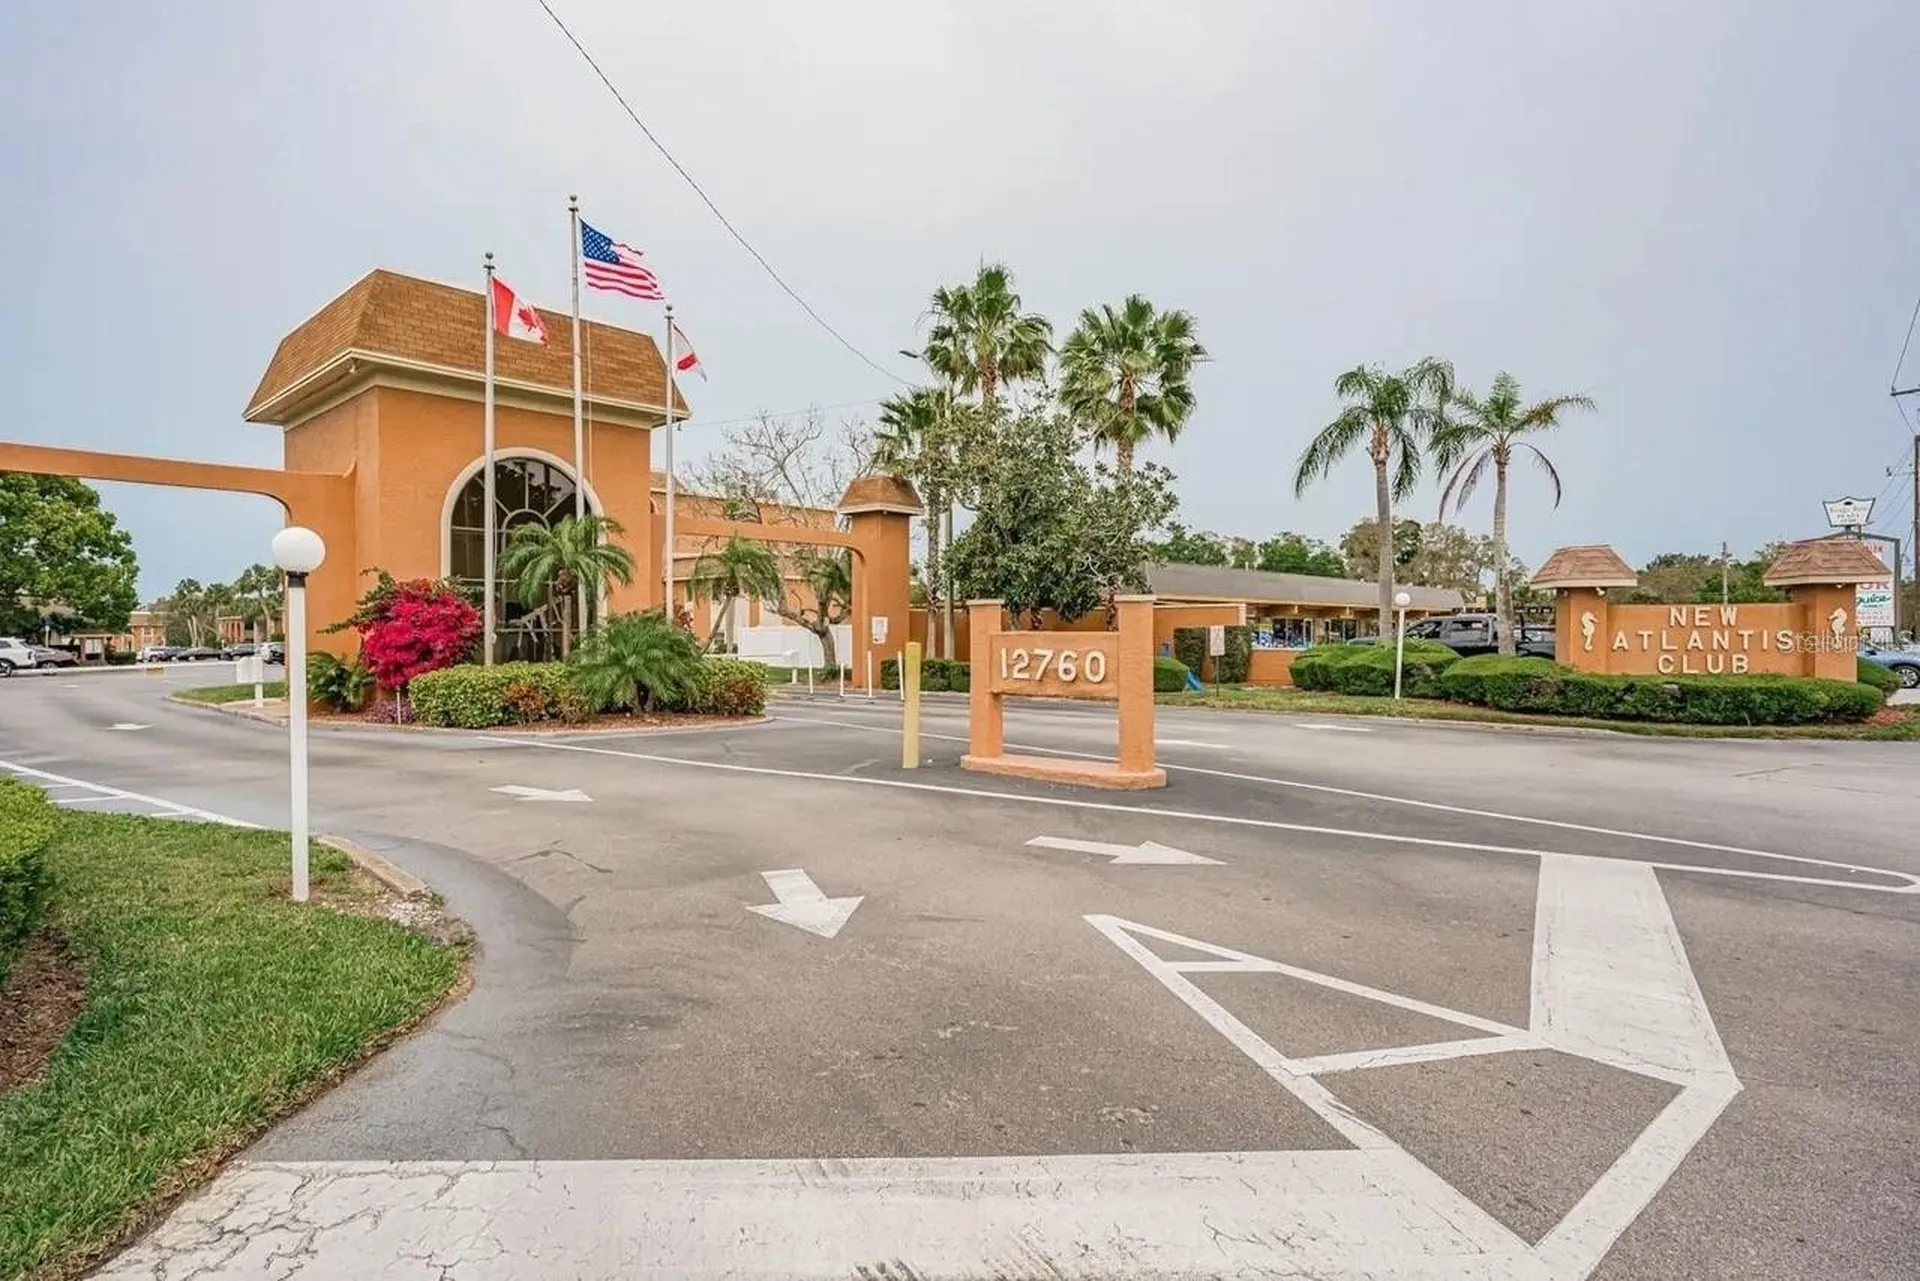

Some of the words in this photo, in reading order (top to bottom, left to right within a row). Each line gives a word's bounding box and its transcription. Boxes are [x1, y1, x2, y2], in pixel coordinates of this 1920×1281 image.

[1669, 606, 1738, 627] NEW
[1612, 630, 1794, 650] ATLANTIS
[1000, 648, 1106, 683] 12760
[1658, 653, 1749, 674] CLUB
